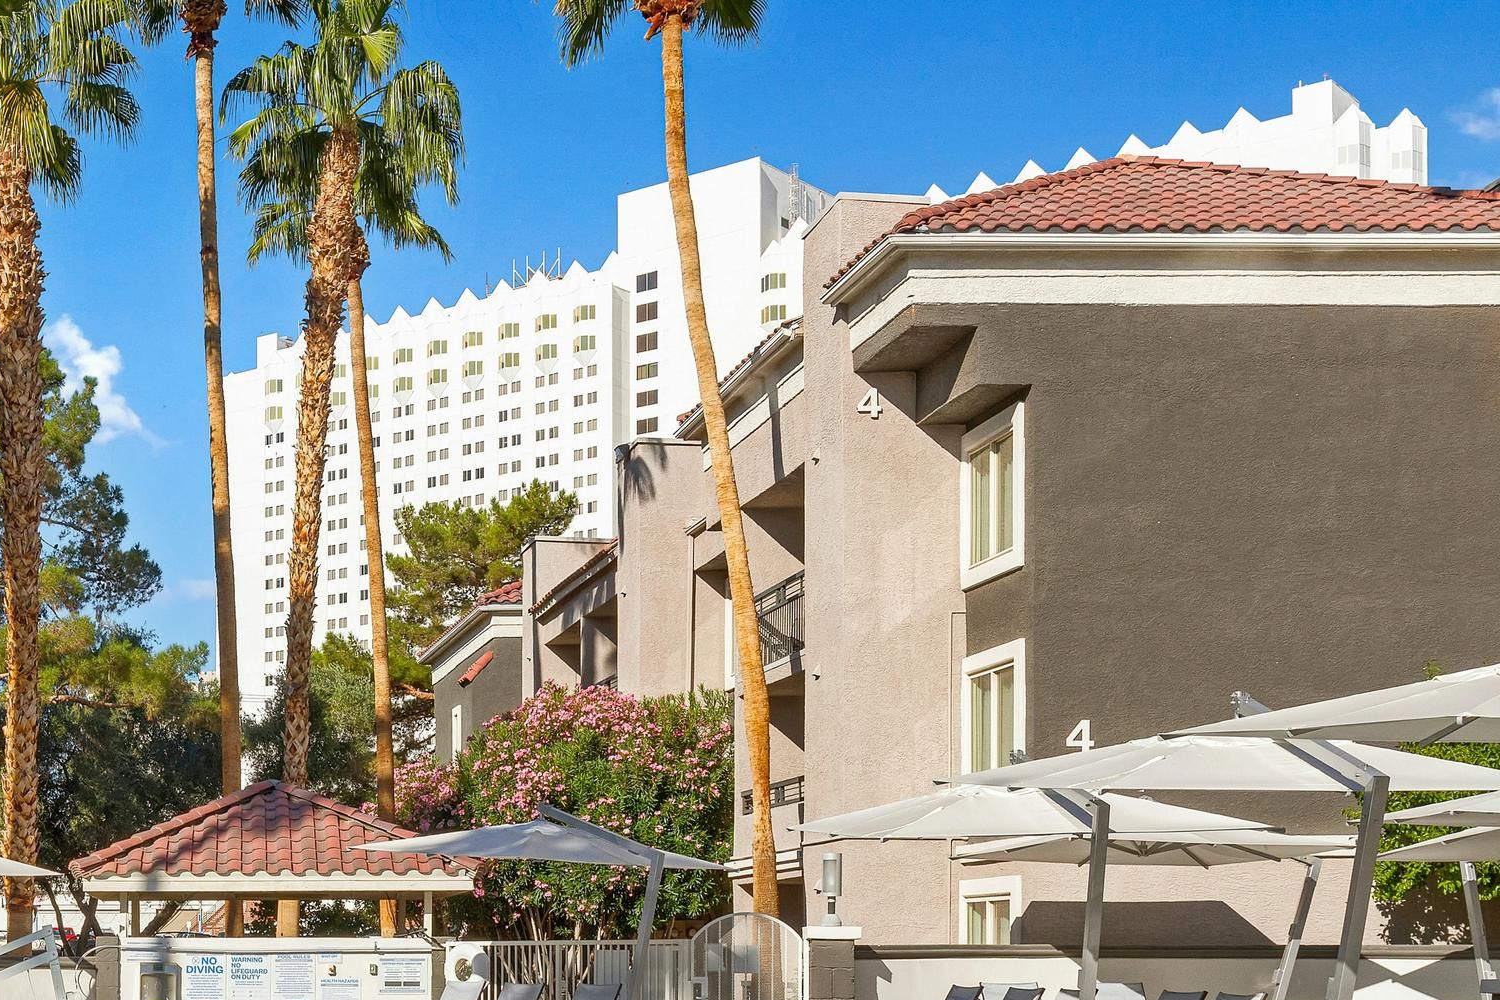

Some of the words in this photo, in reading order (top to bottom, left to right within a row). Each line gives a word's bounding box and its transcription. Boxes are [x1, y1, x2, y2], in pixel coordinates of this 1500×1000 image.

[857, 387, 883, 420] 4
[1066, 719, 1095, 752] 4
[186, 965, 224, 974] DIVING
[201, 956, 217, 965] NO
